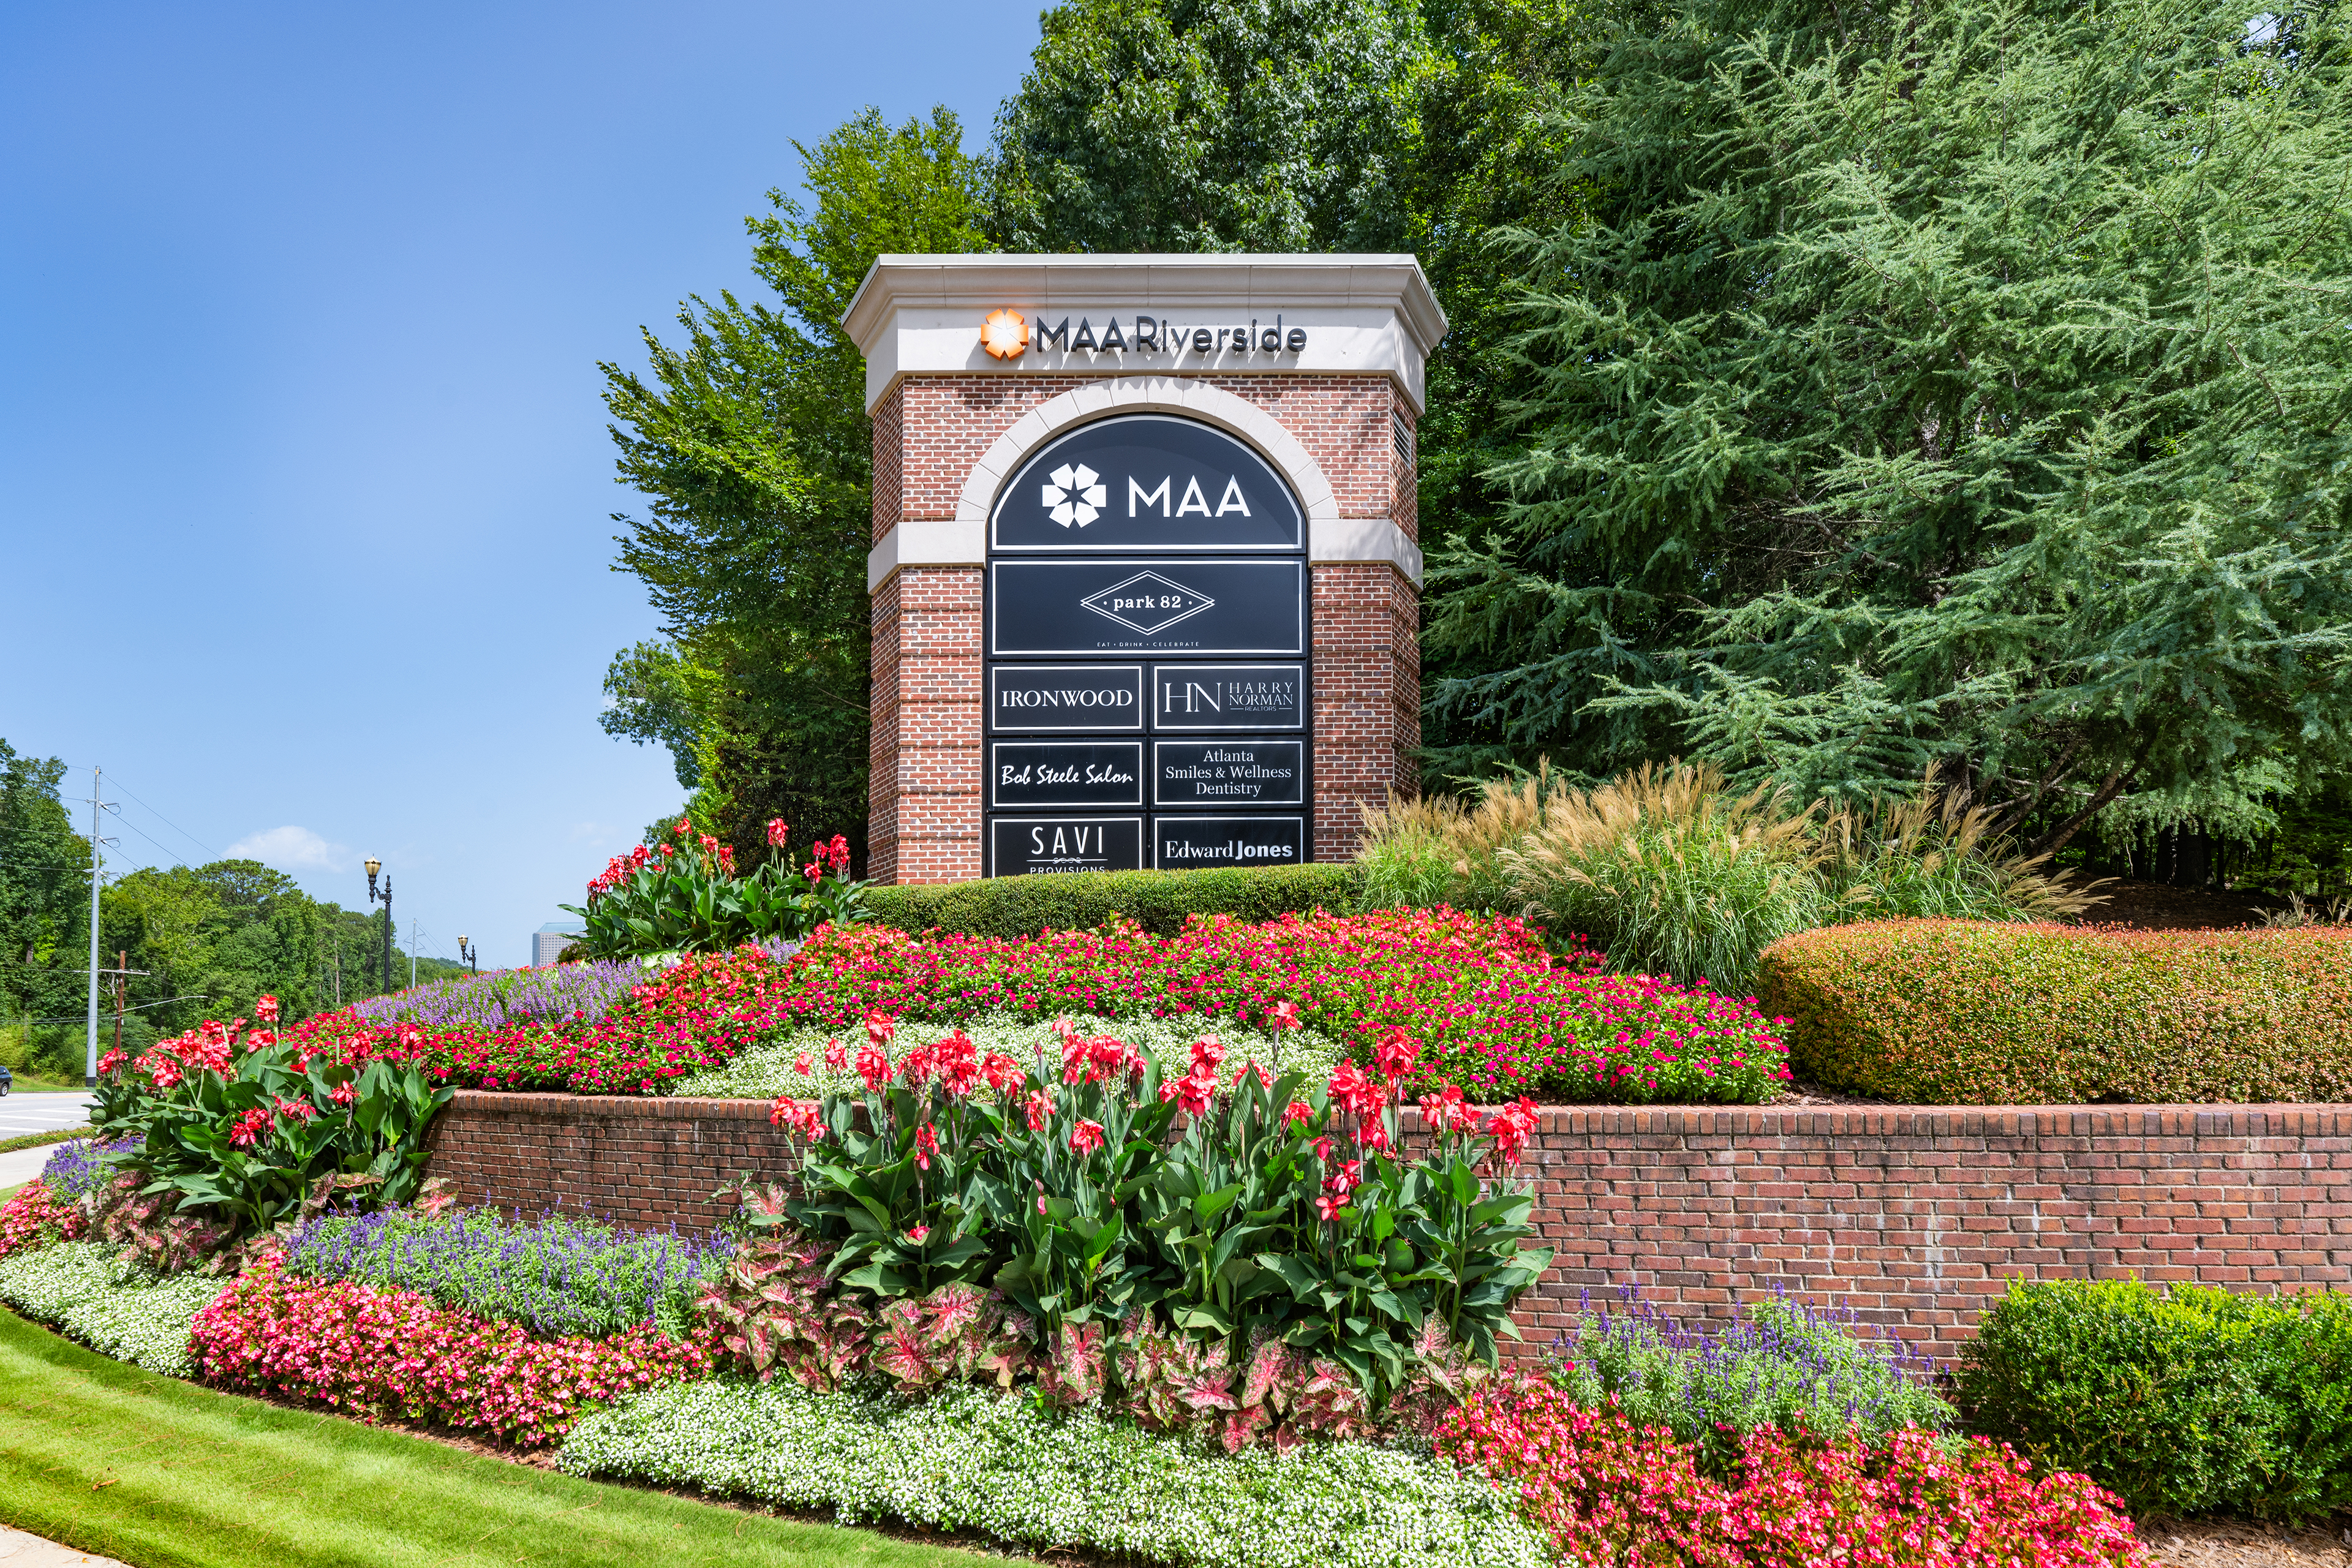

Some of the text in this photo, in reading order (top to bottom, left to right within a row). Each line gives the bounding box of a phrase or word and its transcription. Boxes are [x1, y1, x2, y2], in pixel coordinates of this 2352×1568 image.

[1036, 314, 1307, 353] MAA Riverside
[1128, 475, 1252, 518] MAA
[1113, 595, 1181, 611] park 82
[1229, 682, 1292, 693] HARRY
[1001, 689, 1133, 707] IRONWOOD
[1164, 682, 1222, 712] HN
[1229, 694, 1292, 706] NORMAN
[1203, 749, 1254, 762] Atlanta
[1001, 764, 1133, 786] Bob Steele Salon
[1166, 765, 1292, 778] Smiles & Wellness
[1196, 782, 1262, 797] Dentistry
[1031, 826, 1102, 855] SAVI
[1030, 866, 1105, 875] PROVISIONS
